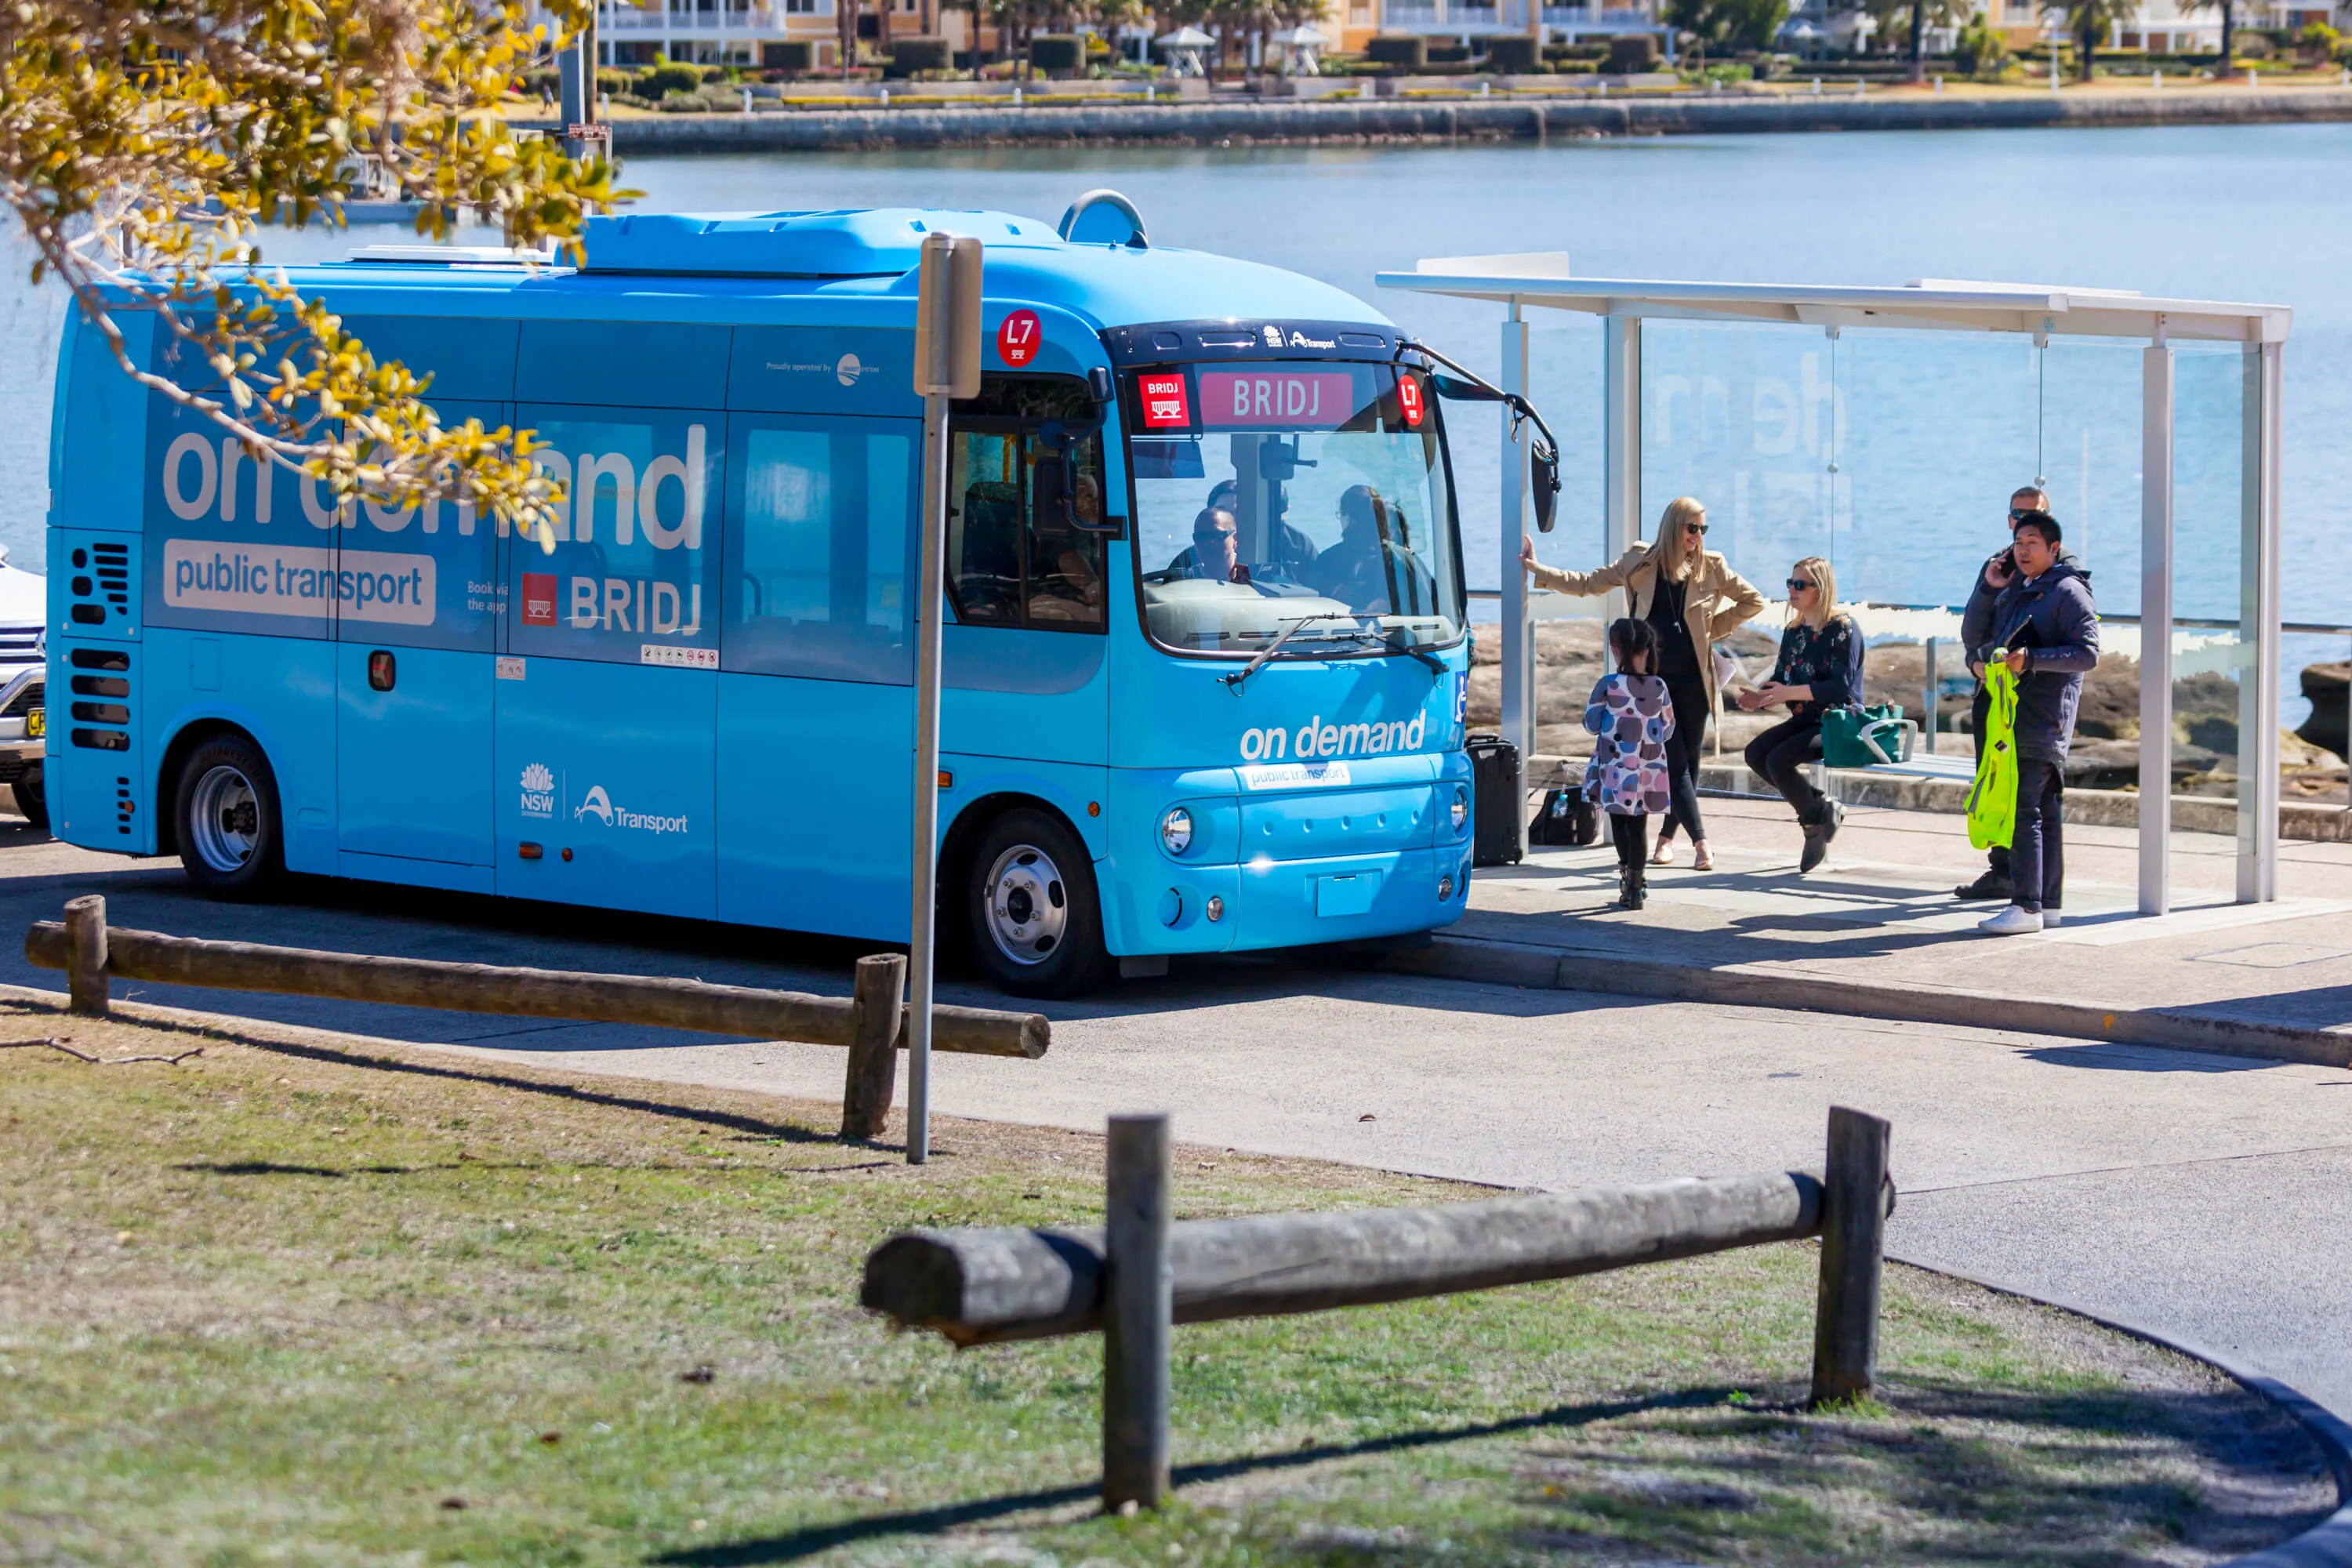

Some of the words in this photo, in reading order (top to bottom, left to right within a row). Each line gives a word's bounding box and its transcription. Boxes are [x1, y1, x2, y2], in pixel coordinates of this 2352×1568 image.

[1007, 320, 1034, 343] L7
[766, 362, 790, 372] Proudly
[793, 363, 821, 372] operated
[824, 363, 831, 373] by
[1148, 383, 1178, 394] BRIDJ
[1234, 379, 1319, 416] BRIDJ
[1401, 384, 1416, 405] L7
[163, 432, 273, 523] on
[176, 554, 267, 597] public
[275, 559, 422, 610] transport
[468, 581, 493, 594] Book
[468, 598, 485, 611] the
[487, 602, 506, 615] app
[572, 576, 700, 636] BRIDJ
[1240, 728, 1287, 760] on
[1295, 708, 1426, 758] demand
[1251, 770, 1289, 786] public
[1290, 766, 1345, 782] transport
[521, 793, 554, 812] NSW
[615, 807, 688, 834] Transport
